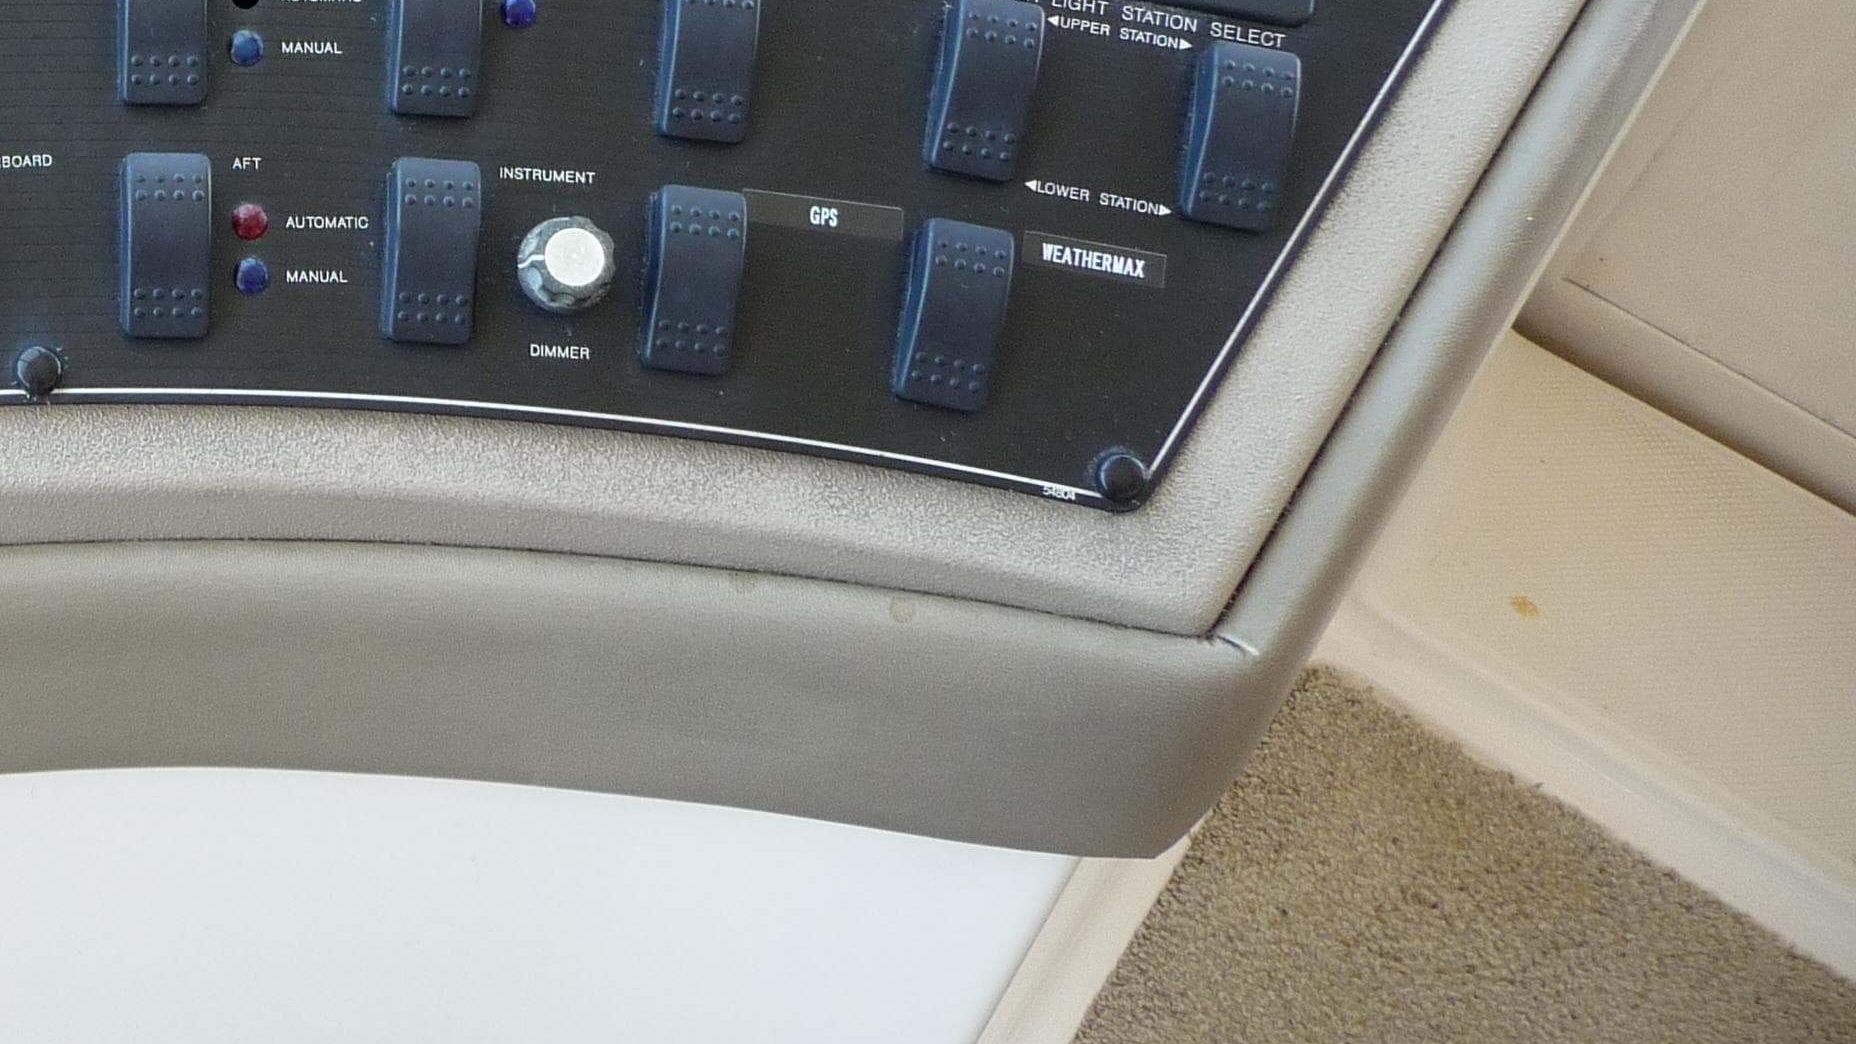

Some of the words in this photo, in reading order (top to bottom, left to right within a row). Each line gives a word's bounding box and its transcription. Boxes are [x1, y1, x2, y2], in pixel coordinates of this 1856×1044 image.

[1059, 17, 1110, 37] UPPER
[1120, 28, 1178, 49] STATION
[1121, 6, 1198, 33] STATION
[1210, 22, 1286, 49] SELECT
[281, 42, 343, 54] MANUAL
[232, 158, 262, 171] AFT
[499, 167, 596, 184] INSTRUMENT
[1036, 181, 1090, 202] LOWER
[1099, 193, 1159, 214] STATION
[285, 216, 369, 230] AUTOMATIC
[810, 206, 838, 227] GPS
[1042, 242, 1145, 278] WEATHERMAX
[286, 270, 348, 284] MANUAL
[530, 343, 590, 361] DIMMER
